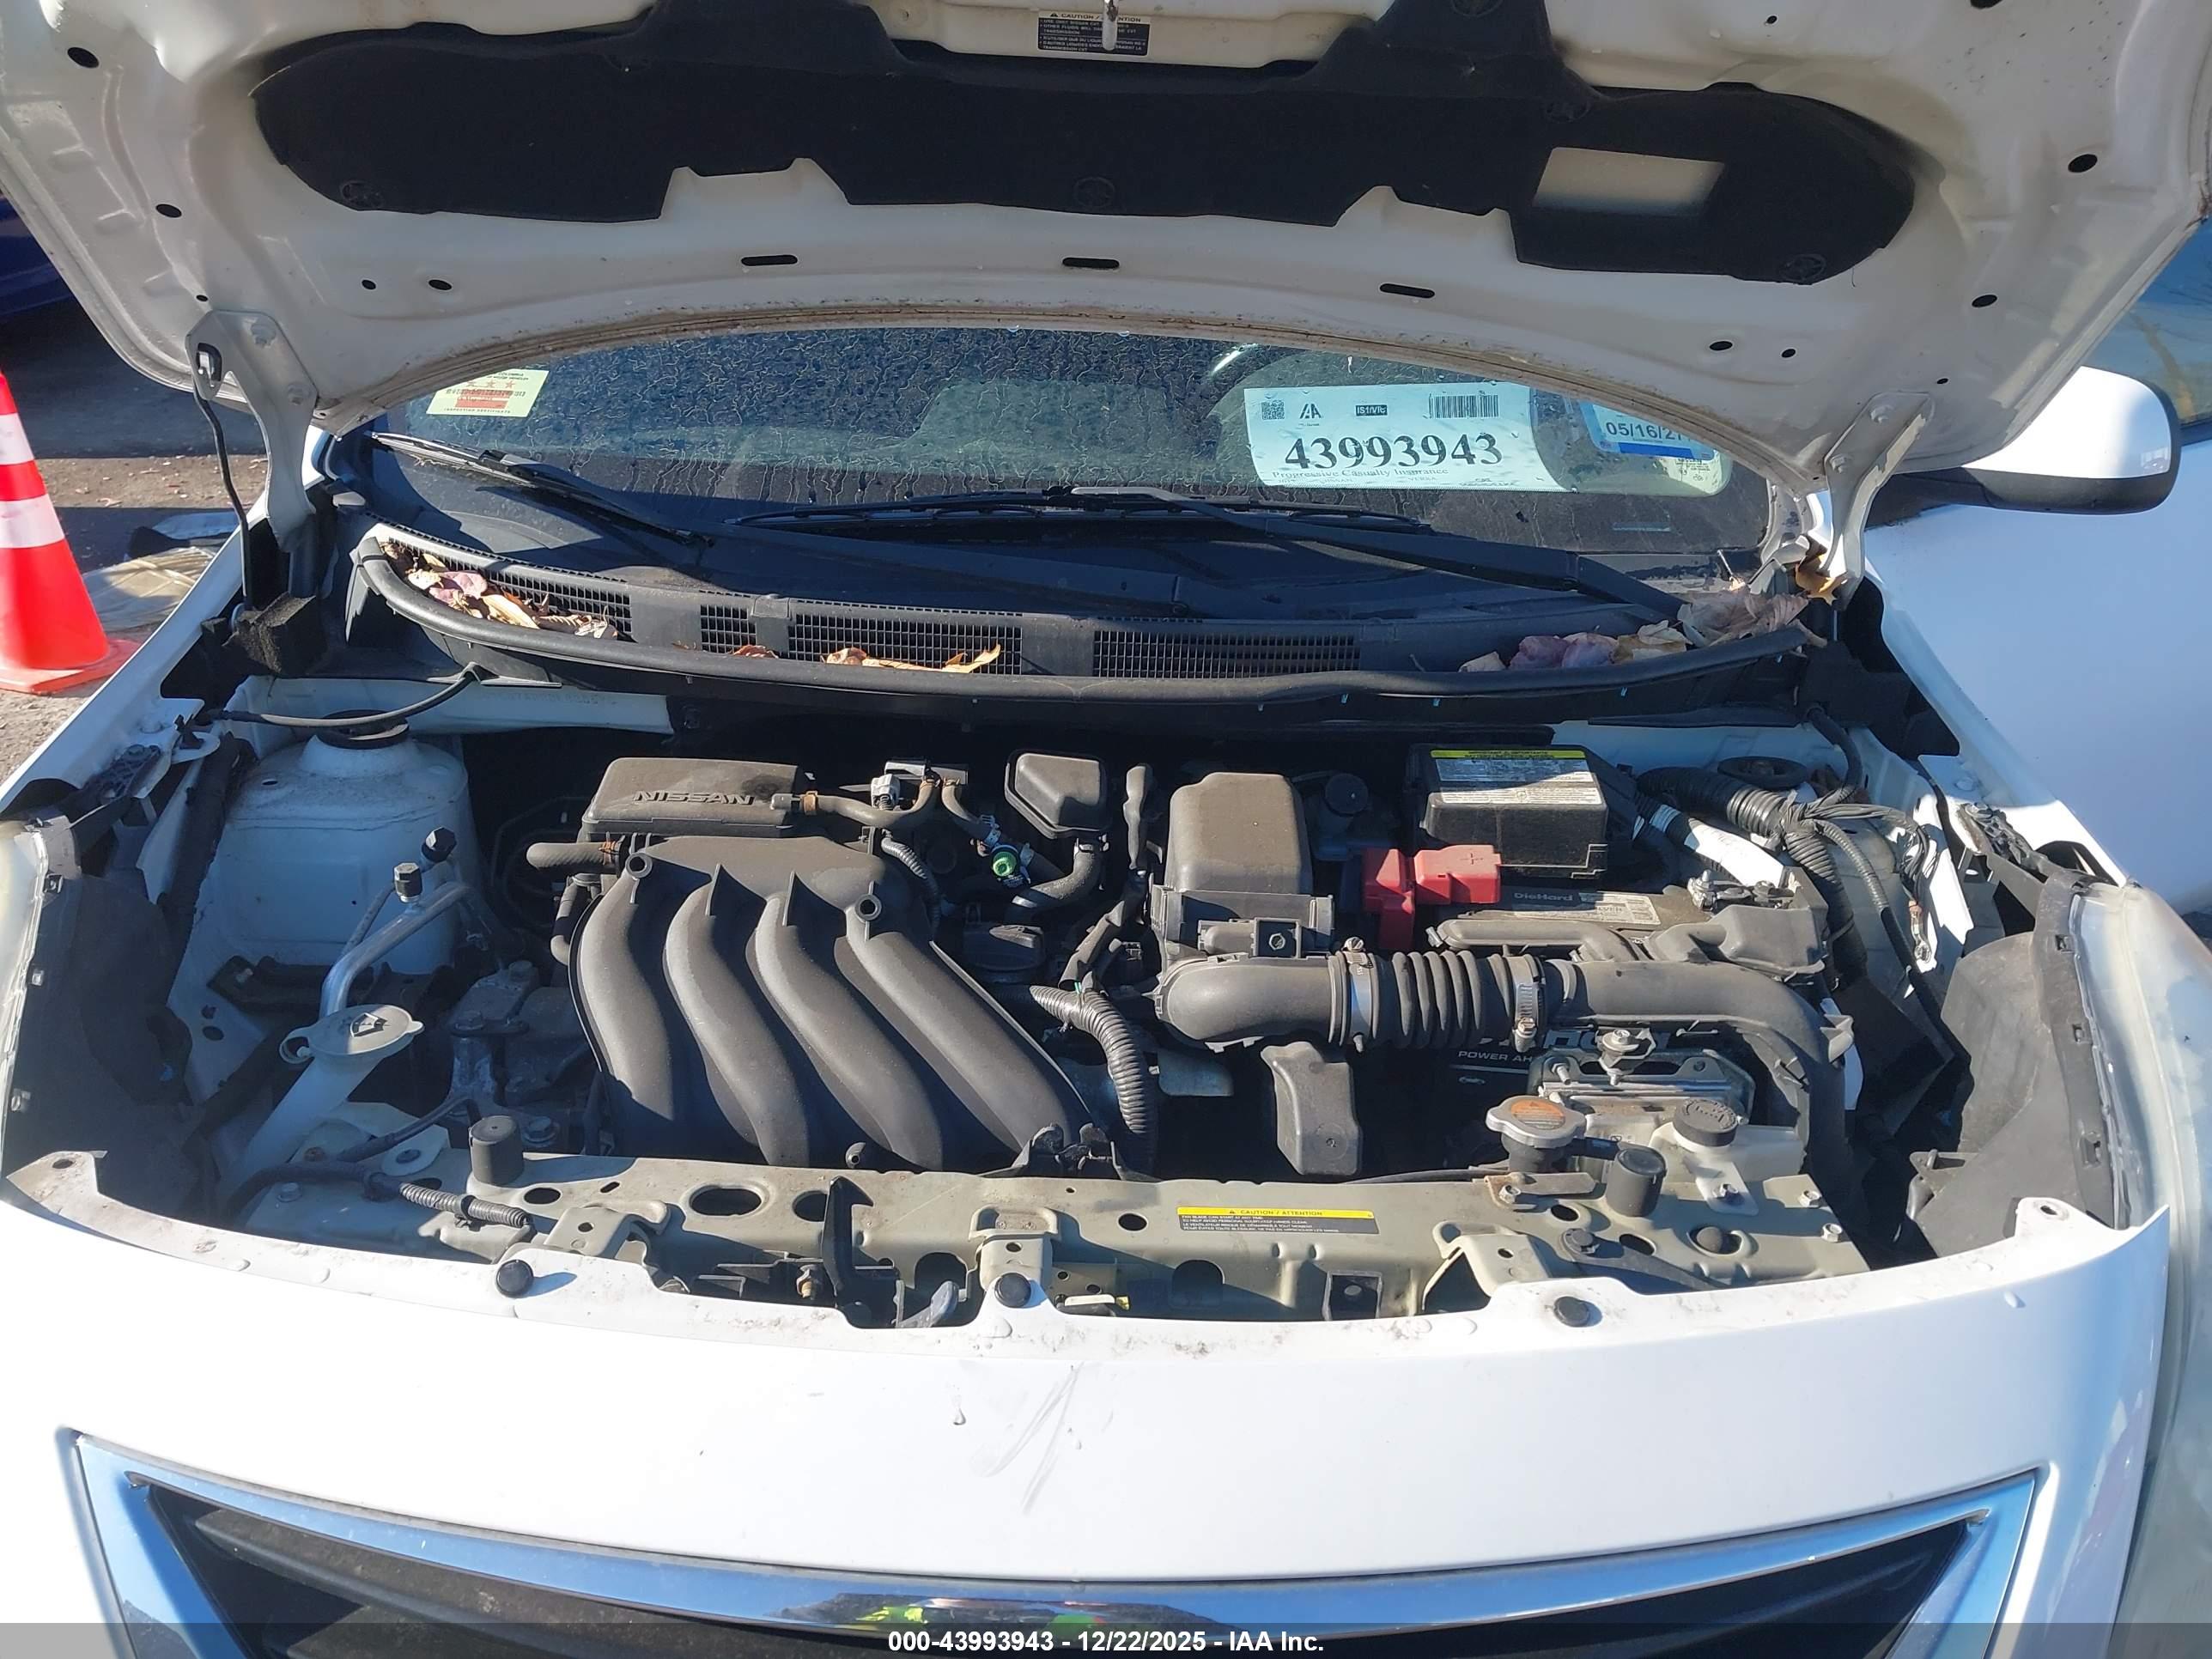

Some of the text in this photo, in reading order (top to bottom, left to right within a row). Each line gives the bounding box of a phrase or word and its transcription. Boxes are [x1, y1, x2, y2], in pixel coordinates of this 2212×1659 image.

[1285, 432, 1503, 470] 43993943
[1272, 470, 1340, 479] Progressive
[1341, 469, 1390, 478] Casualty
[633, 790, 756, 805] NISSAN
[1513, 892, 1574, 902] DieHard
[1458, 1050, 1509, 1060] POWER
